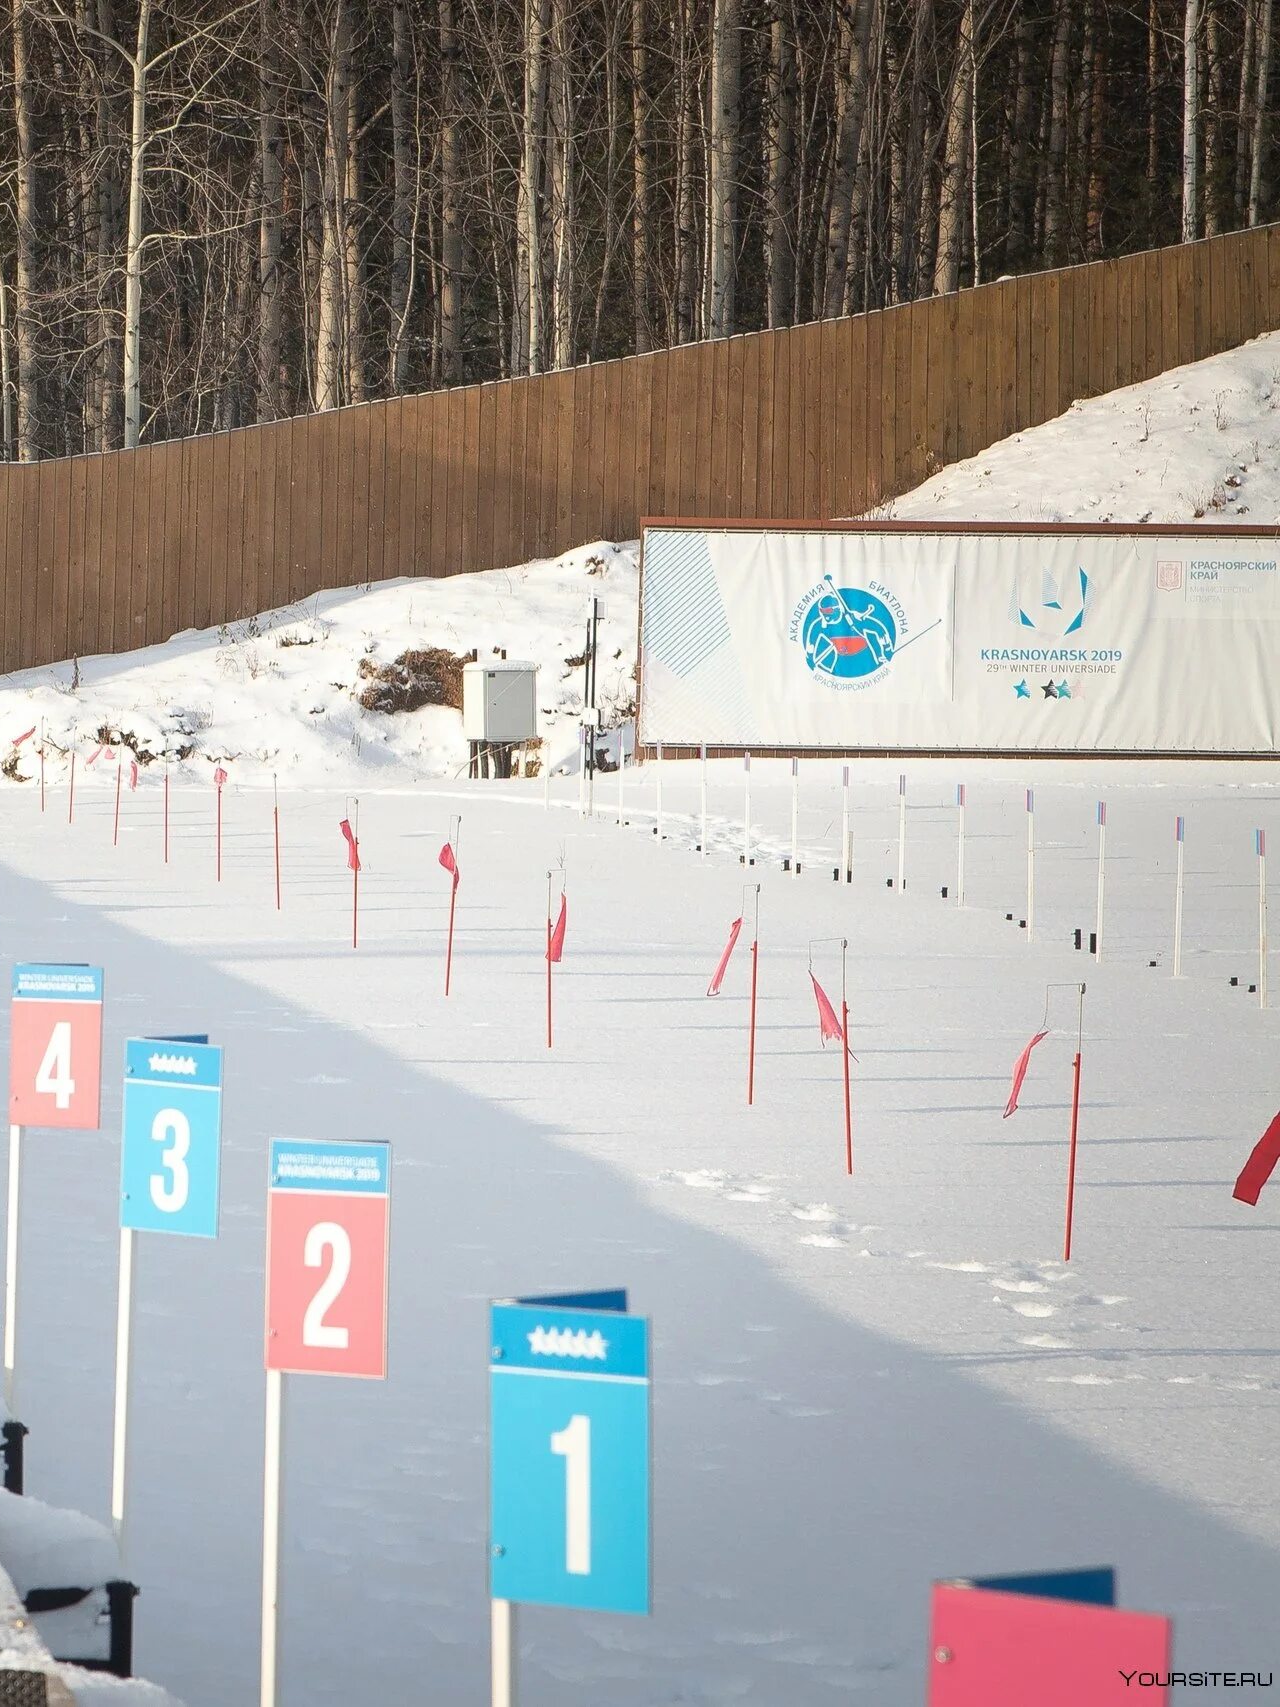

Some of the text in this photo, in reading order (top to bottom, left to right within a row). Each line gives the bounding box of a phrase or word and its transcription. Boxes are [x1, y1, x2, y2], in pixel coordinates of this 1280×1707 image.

[1190, 560, 1277, 570] КРАСНОЯРСКИЙ
[1190, 571, 1218, 580] КРАЙ
[789, 580, 909, 643] АКАДЕМИЯ БИАТЛОНА
[981, 649, 1123, 661] KRASNOYARSK 2019
[1010, 664, 1047, 673] WINTER
[1050, 664, 1117, 674] UNIVERSIADE
[812, 667, 892, 692] КРАСНОЯРСКИЙ КРАЙ
[35, 1022, 76, 1109] 4
[149, 1108, 191, 1213] 3
[302, 1221, 352, 1349] 2
[550, 1414, 591, 1576] 1
